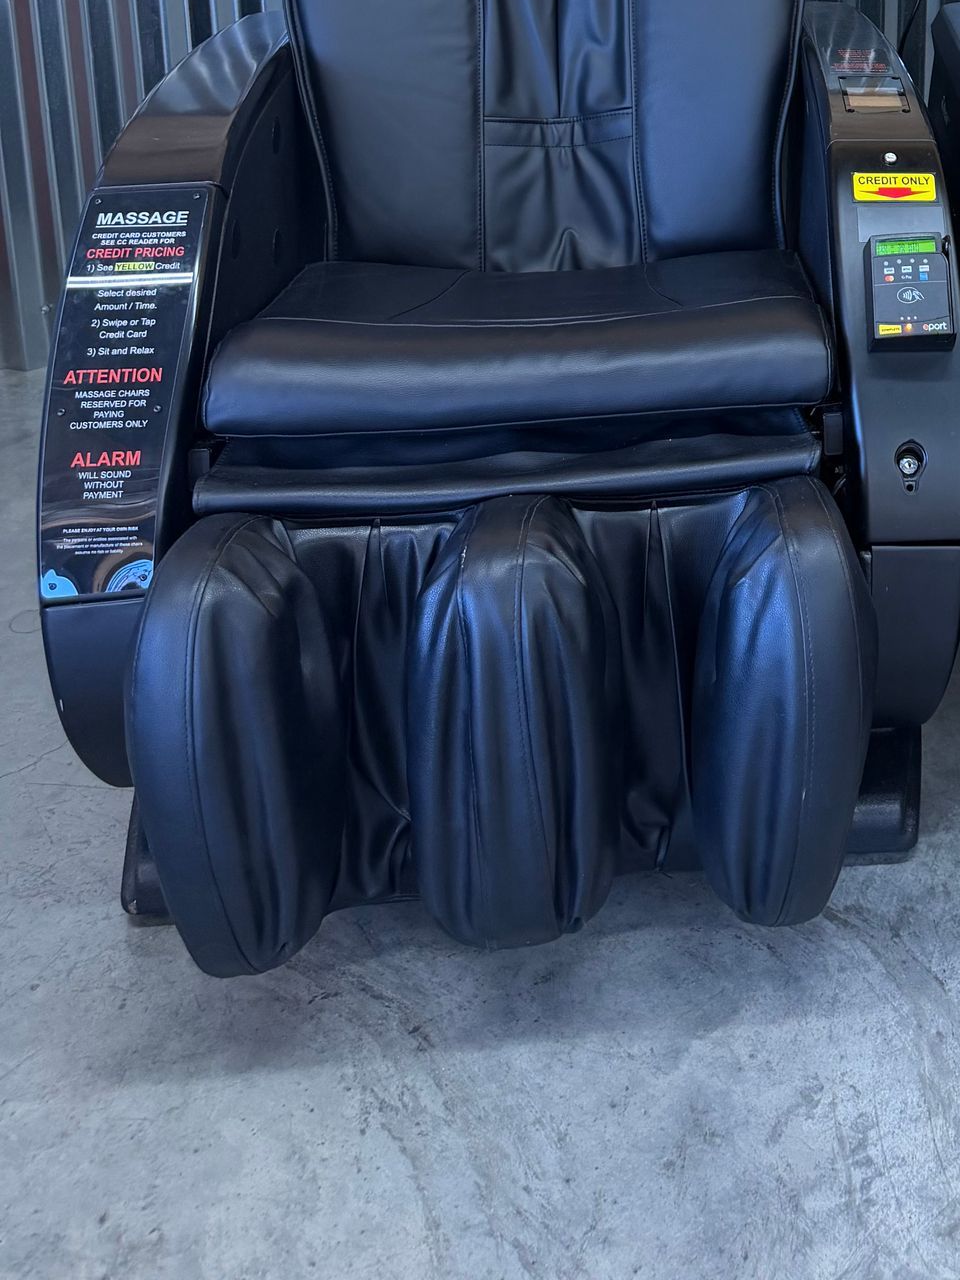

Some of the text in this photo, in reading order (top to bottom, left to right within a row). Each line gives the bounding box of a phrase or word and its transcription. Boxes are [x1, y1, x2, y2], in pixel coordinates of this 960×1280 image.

[858, 176, 930, 185] CREDIT ONLY
[96, 211, 189, 225] MASSAGE
[86, 247, 185, 259] CREDIT PRICING
[87, 264, 95, 273] 1)
[115, 262, 155, 271] YELLOW
[155, 262, 180, 270] Credit
[98, 288, 157, 297] Select desired
[135, 302, 157, 310] Time.
[91, 319, 100, 328] 2)
[102, 319, 128, 328] Swipe
[141, 318, 156, 327] Tap
[923, 321, 947, 332] eport
[99, 331, 125, 339] Credit
[87, 348, 96, 357] 3)
[111, 347, 128, 355] and
[64, 368, 163, 385] ATTENTION
[75, 389, 150, 399] MASSAGE CHAIRS
[80, 399, 146, 409] RESERVED FOR
[94, 410, 124, 418] PAYING
[69, 420, 148, 430] CUSTOMERS ONLY
[70, 450, 141, 468] ALARM
[78, 470, 131, 480] WILL SOUND
[84, 481, 124, 489] WITHOUT
[83, 491, 123, 500] PAYMENT
